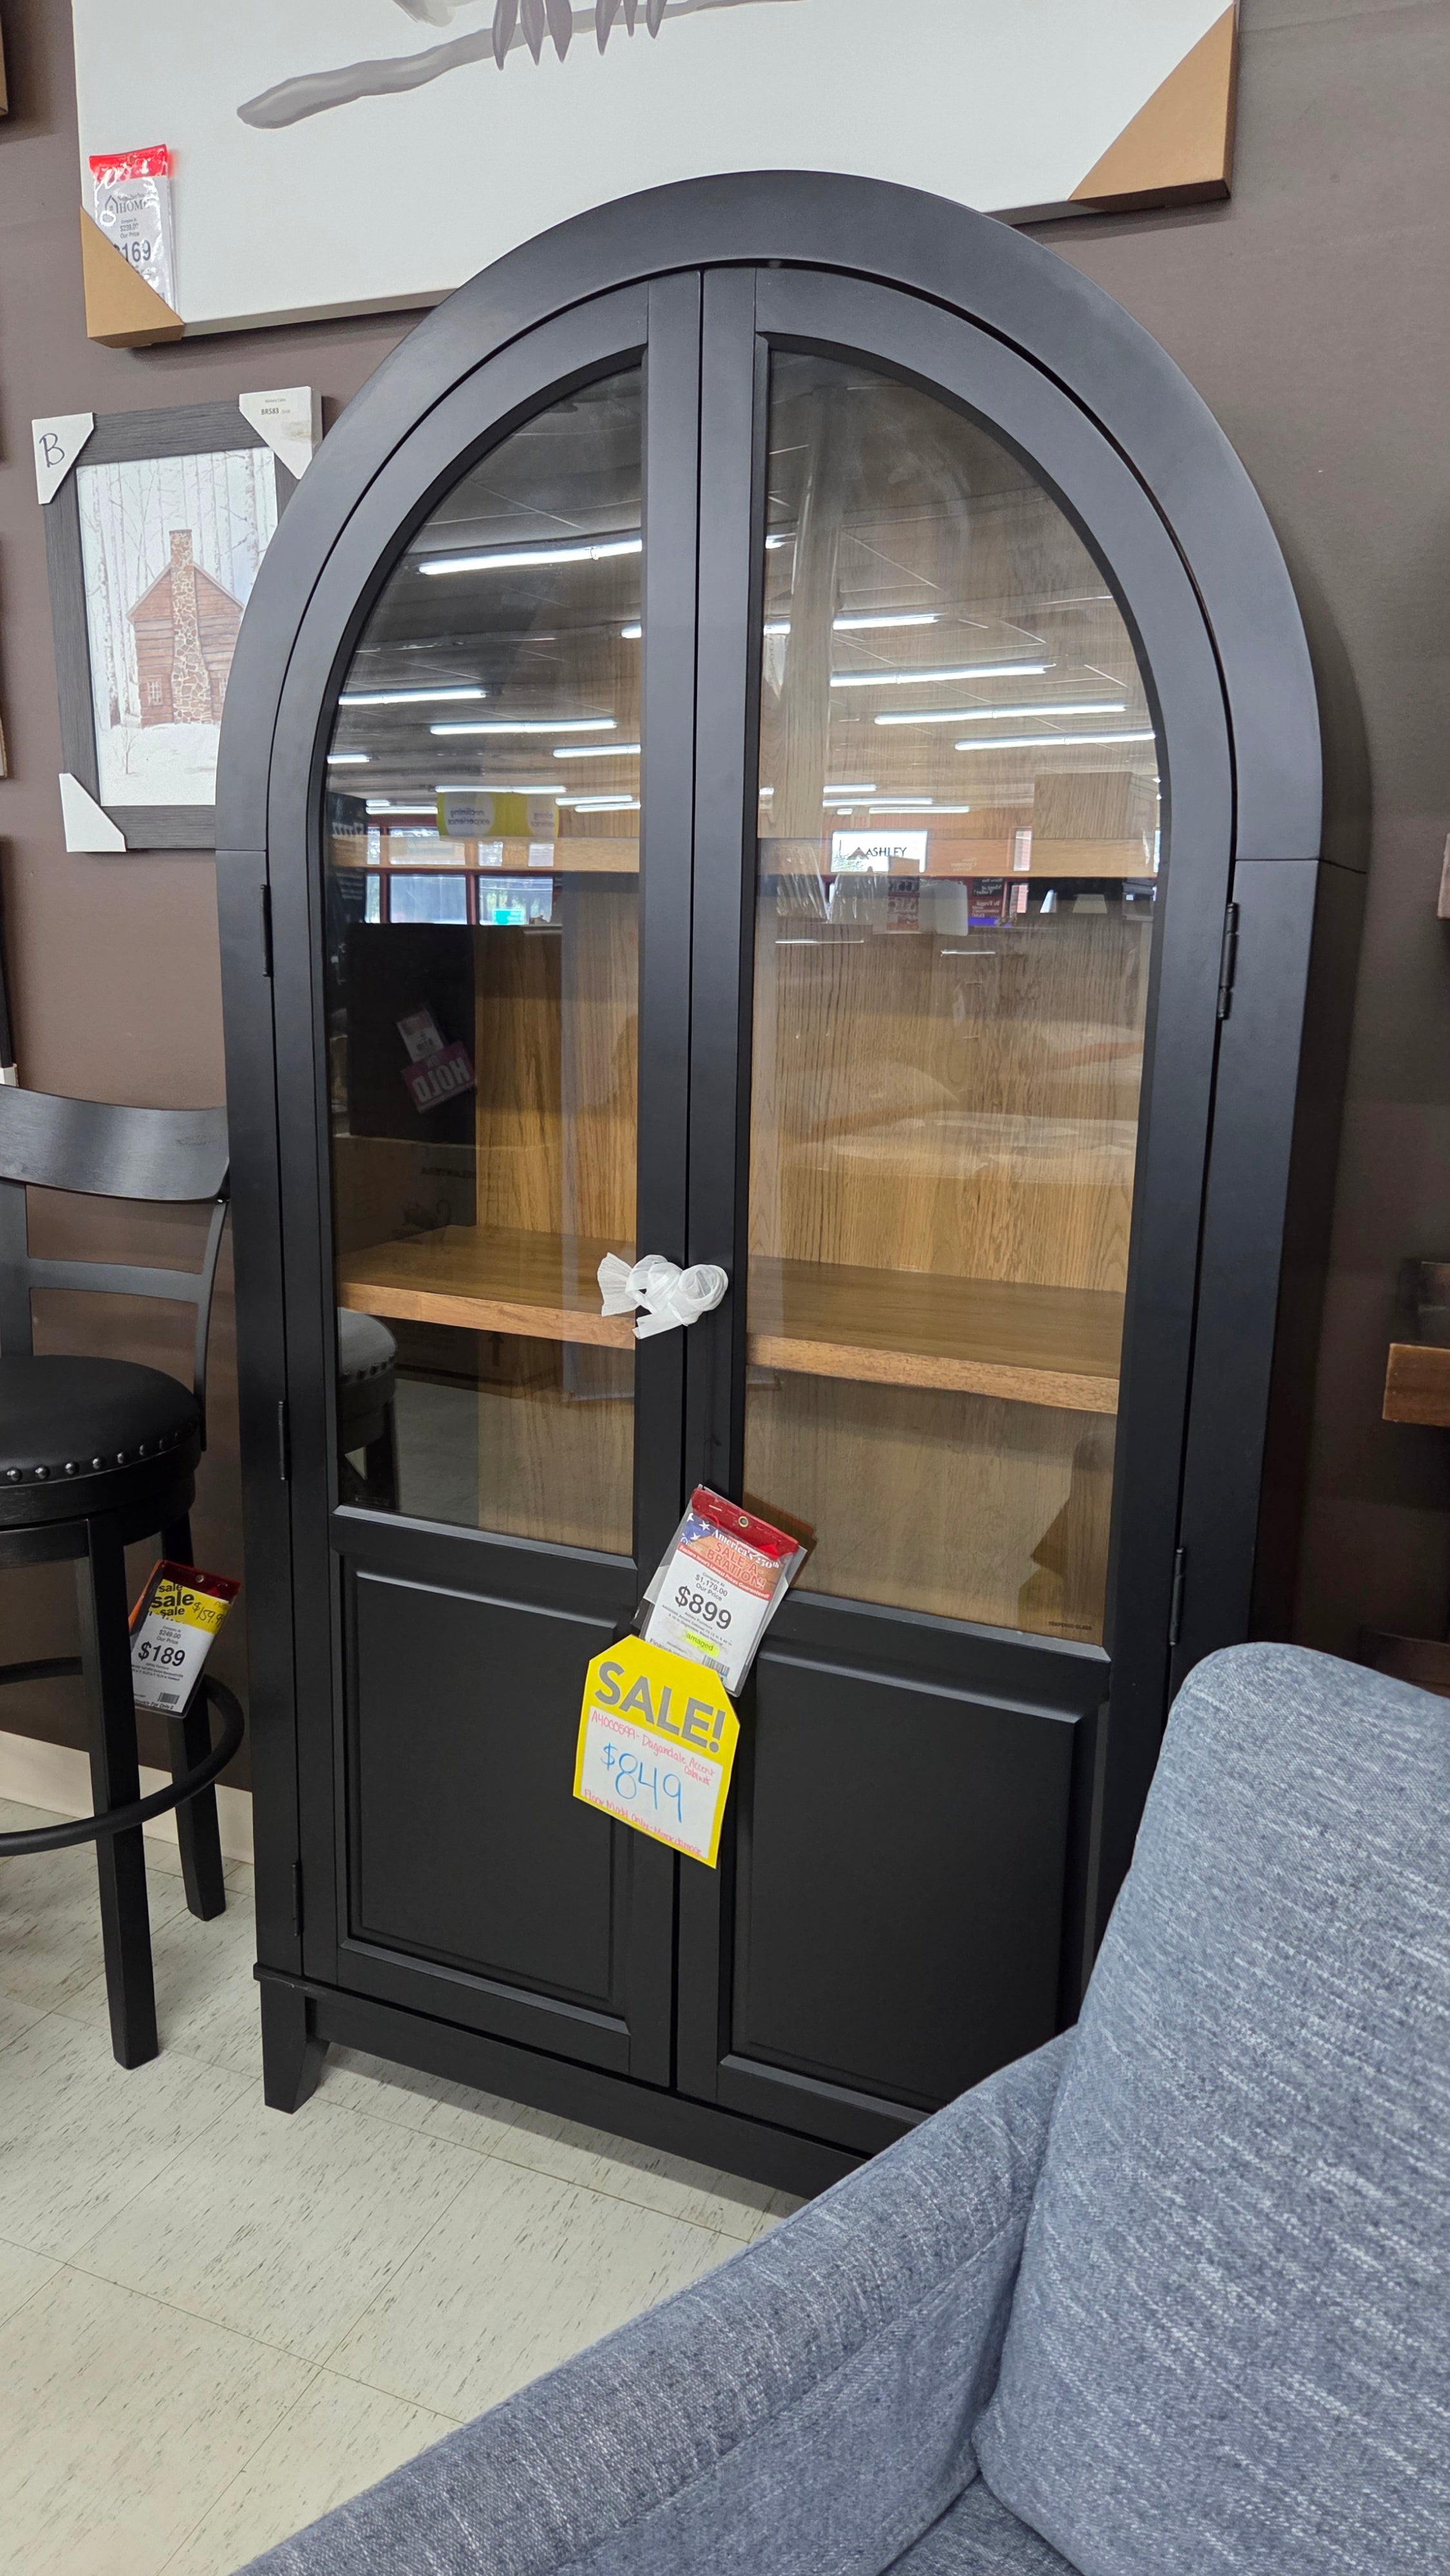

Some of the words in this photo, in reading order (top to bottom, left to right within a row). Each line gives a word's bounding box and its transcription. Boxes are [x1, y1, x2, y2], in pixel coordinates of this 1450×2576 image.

[39, 433, 65, 468] B
[712, 1530, 753, 1560] America's
[679, 1546, 696, 1559] Eastern
[710, 1562, 725, 1577] Lowest
[724, 1573, 739, 1585] Prices
[159, 1582, 183, 1593] sale
[695, 1574, 728, 1597] $1,179.00
[695, 1583, 708, 1593] Our
[708, 1590, 722, 1602] Price
[151, 1590, 194, 1609] sale
[160, 1605, 185, 1617] sale
[675, 1586, 732, 1629] $899
[138, 1641, 185, 1667] $189
[686, 1633, 714, 1651] amaged
[594, 1661, 726, 1754] SALE!
[601, 1742, 683, 1824] $849
